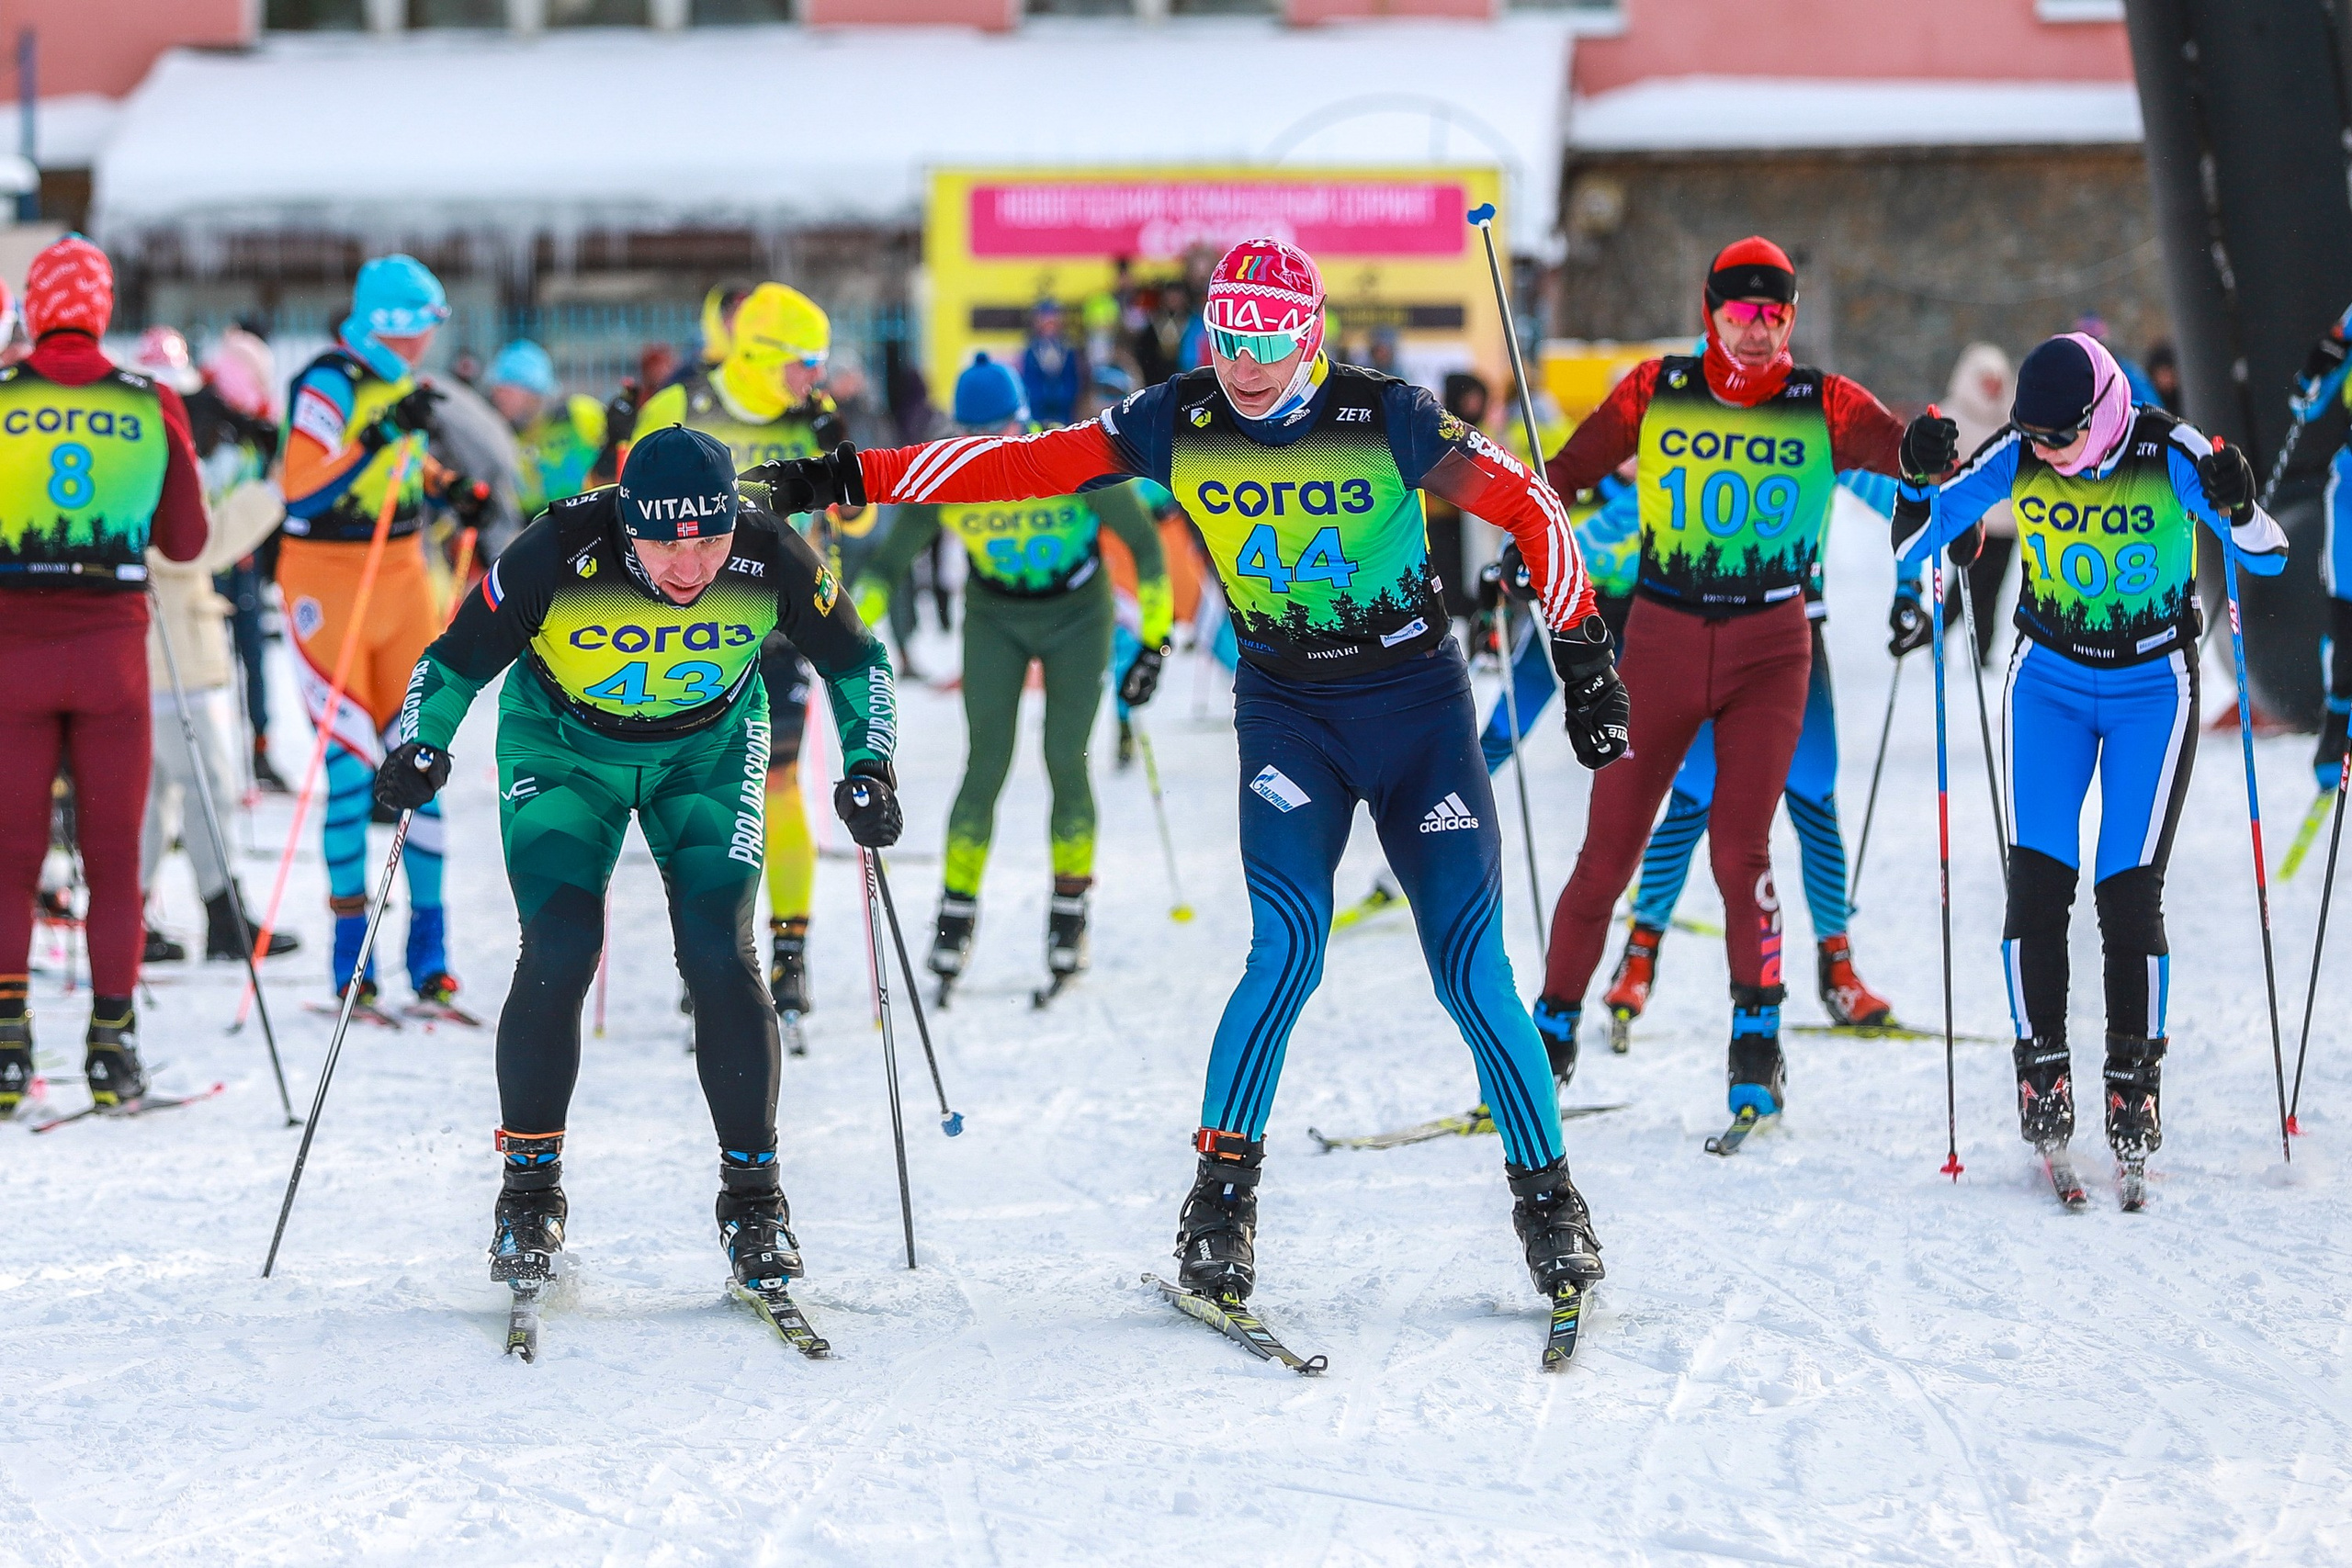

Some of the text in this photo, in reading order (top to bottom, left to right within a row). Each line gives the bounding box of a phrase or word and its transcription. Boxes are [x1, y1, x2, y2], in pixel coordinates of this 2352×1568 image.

[5, 406, 142, 442] согаз
[1467, 431, 1525, 479] SCANIA
[1658, 428, 1806, 467] согаз
[49, 441, 95, 509] 8
[1197, 479, 1376, 518] согаз
[1658, 467, 1801, 539] 109
[2020, 496, 2155, 535] согаз
[986, 534, 1064, 575] 50
[1236, 524, 1359, 593] 44
[2025, 533, 2159, 598] 108
[569, 622, 756, 654] согаз
[1306, 645, 1360, 660] DIWARI
[583, 660, 726, 706] 43
[1419, 814, 1480, 834] adidas
